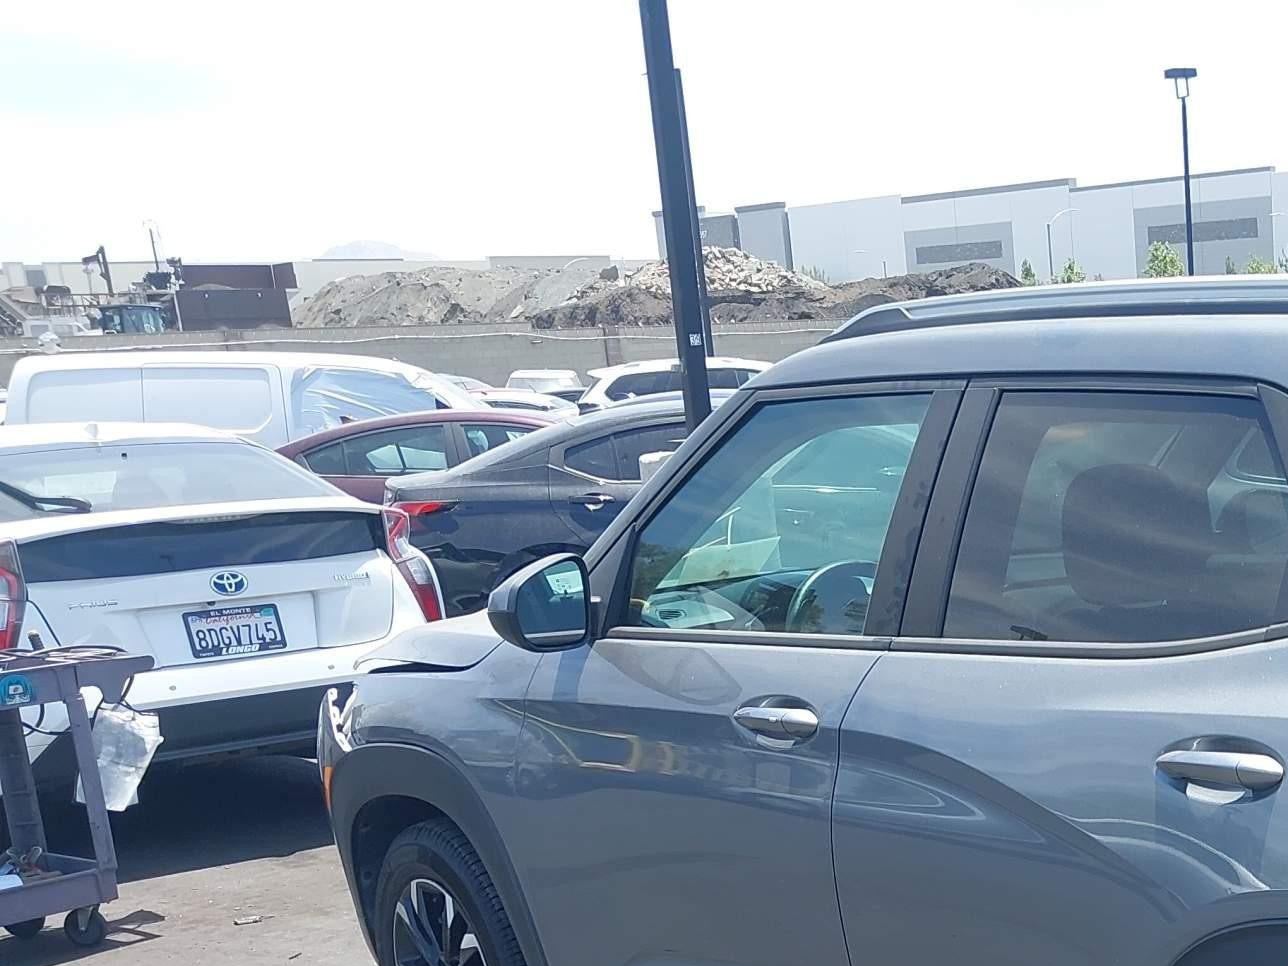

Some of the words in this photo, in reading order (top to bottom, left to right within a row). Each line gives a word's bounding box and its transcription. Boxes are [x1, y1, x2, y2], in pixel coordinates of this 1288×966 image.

[222, 607, 251, 615] MONTE
[195, 621, 278, 650] 8DGV745
[221, 643, 260, 655] LONGO
